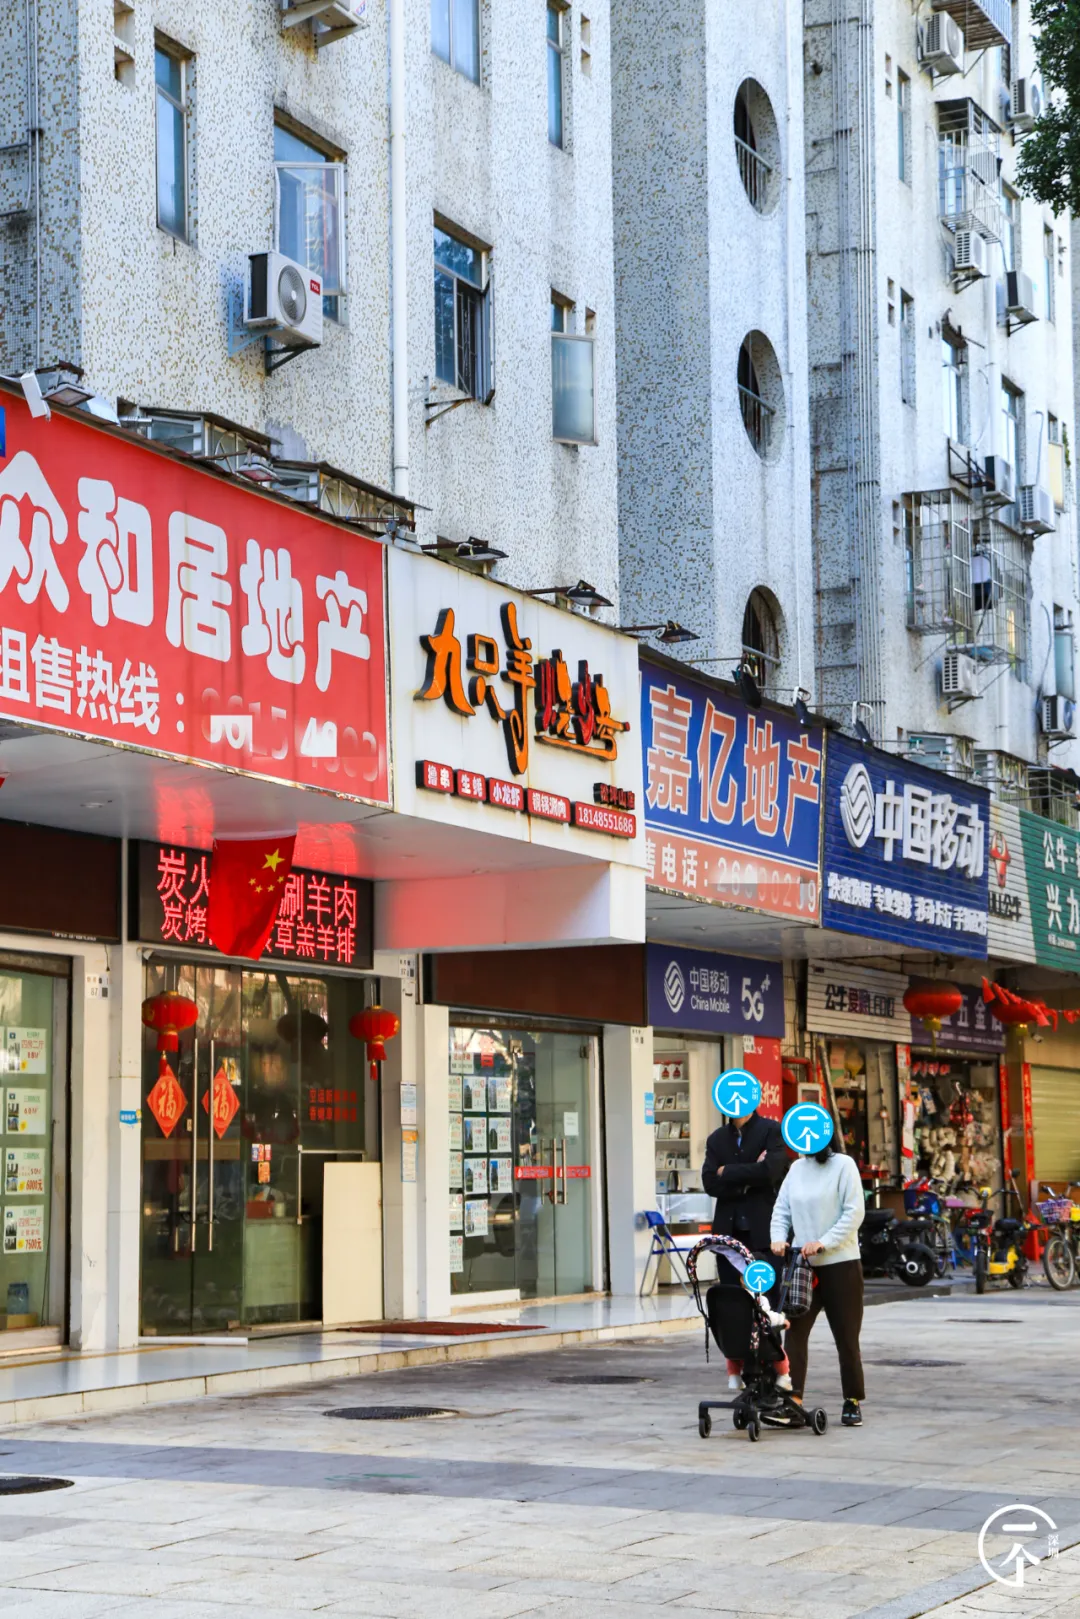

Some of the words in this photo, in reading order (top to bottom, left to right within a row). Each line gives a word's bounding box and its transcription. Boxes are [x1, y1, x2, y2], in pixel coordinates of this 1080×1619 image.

[0, 451, 372, 692] 众和居地产
[645, 684, 821, 847] 嘉亿地产
[493, 782, 521, 808] 小龙虾
[578, 806, 634, 834] 18148551686
[874, 780, 984, 879] 中国移动
[690, 967, 729, 995] 中国移动
[690, 995, 709, 1012] China
[710, 998, 730, 1014] Mobile
[158, 1080, 177, 1121] 福
[213, 1082, 230, 1121] 福
